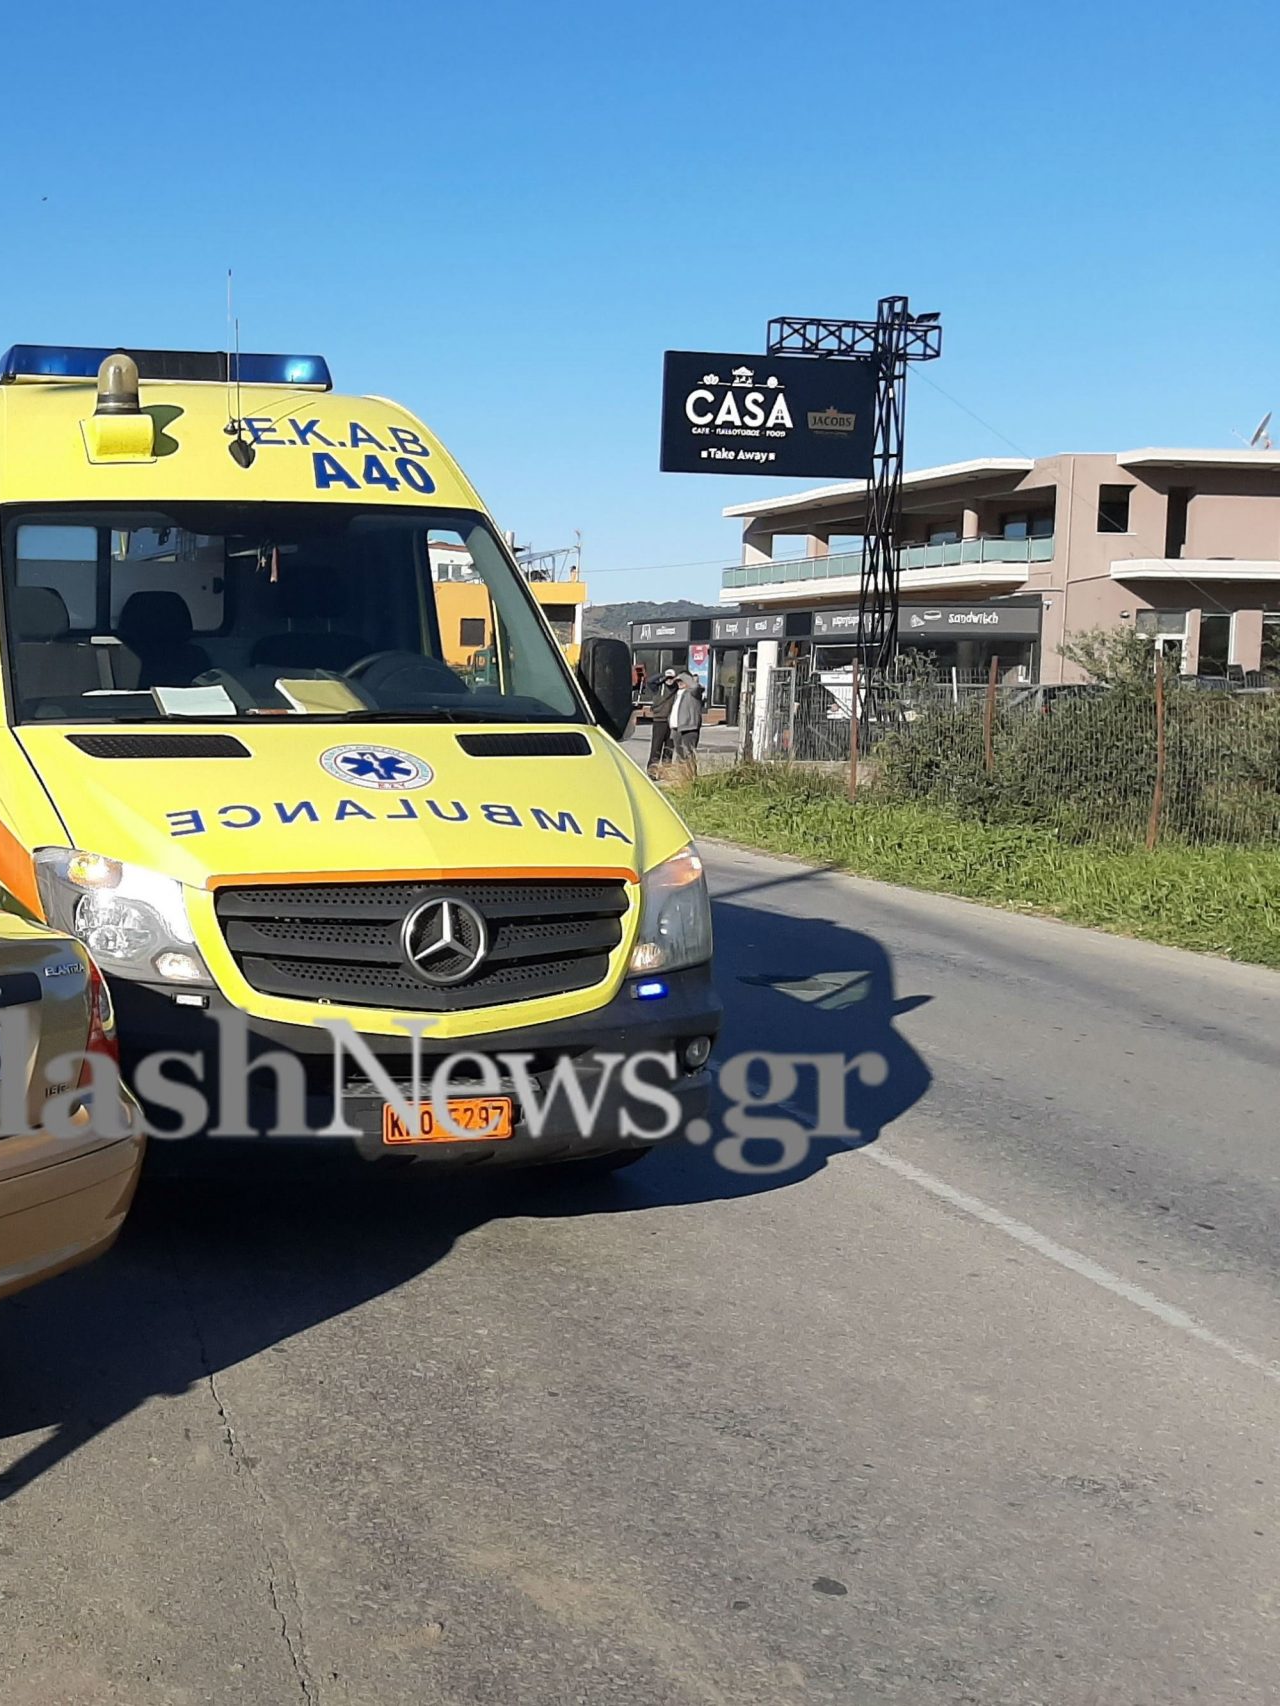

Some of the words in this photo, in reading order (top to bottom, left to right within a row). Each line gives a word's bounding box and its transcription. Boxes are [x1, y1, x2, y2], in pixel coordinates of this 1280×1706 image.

[685, 389, 793, 428] CASA
[813, 415, 852, 428] JACOBS
[242, 417, 430, 457] E.K.A.B
[708, 447, 735, 460] Take
[736, 449, 768, 463] Away
[312, 452, 436, 494] A40
